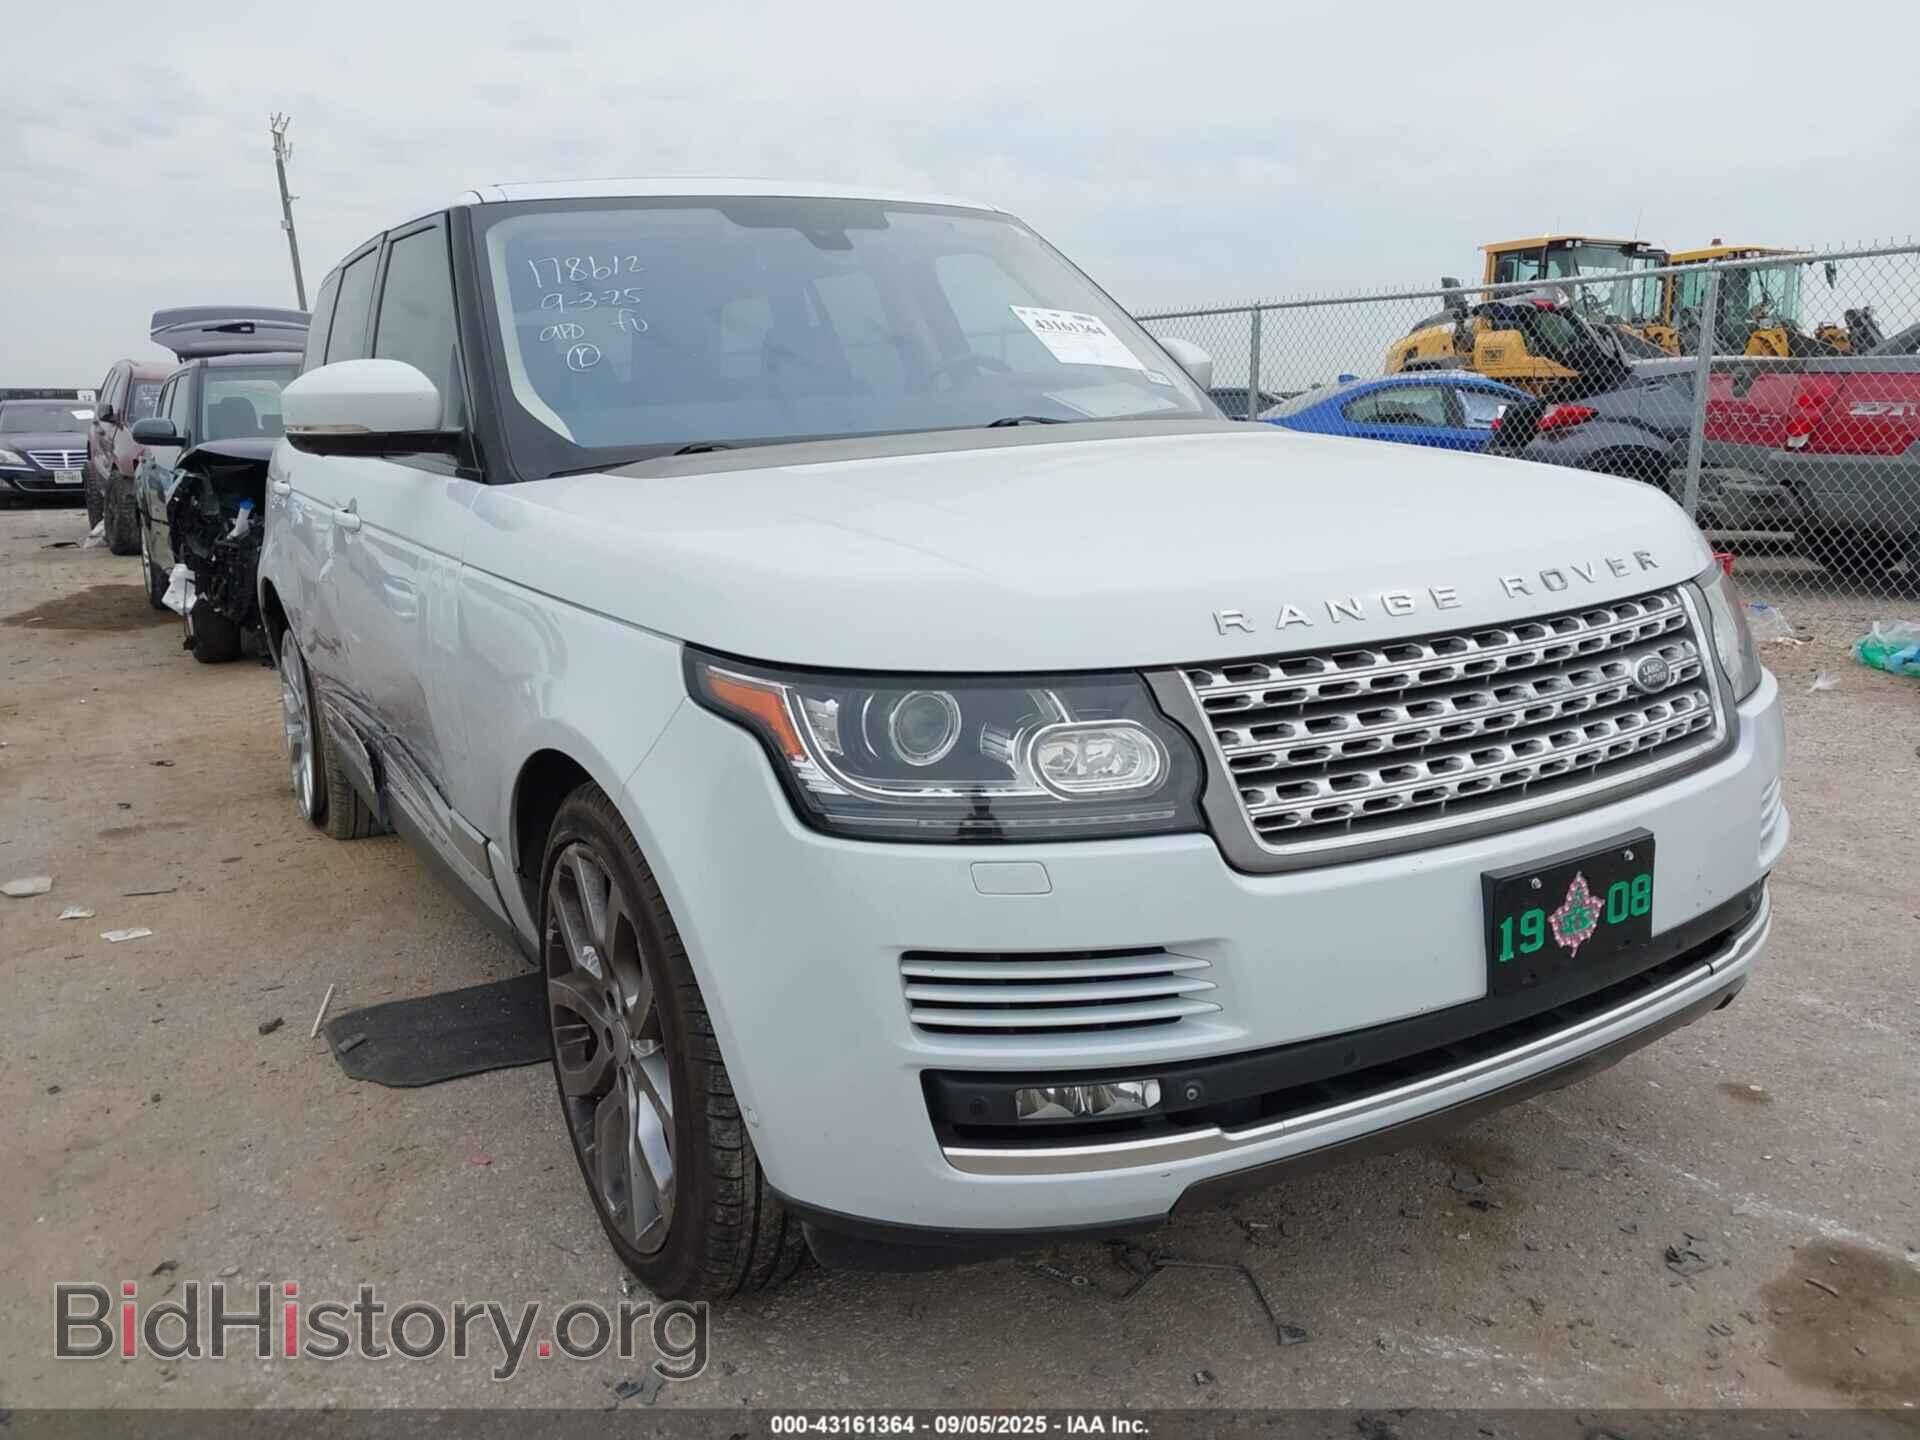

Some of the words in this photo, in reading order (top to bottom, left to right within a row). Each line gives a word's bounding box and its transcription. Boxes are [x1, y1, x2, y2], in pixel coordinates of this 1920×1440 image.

[1212, 585, 1463, 635] RANGE
[1499, 549, 1660, 599] ROVER
[1499, 908, 1546, 962] 19
[1607, 874, 1652, 925] 08
